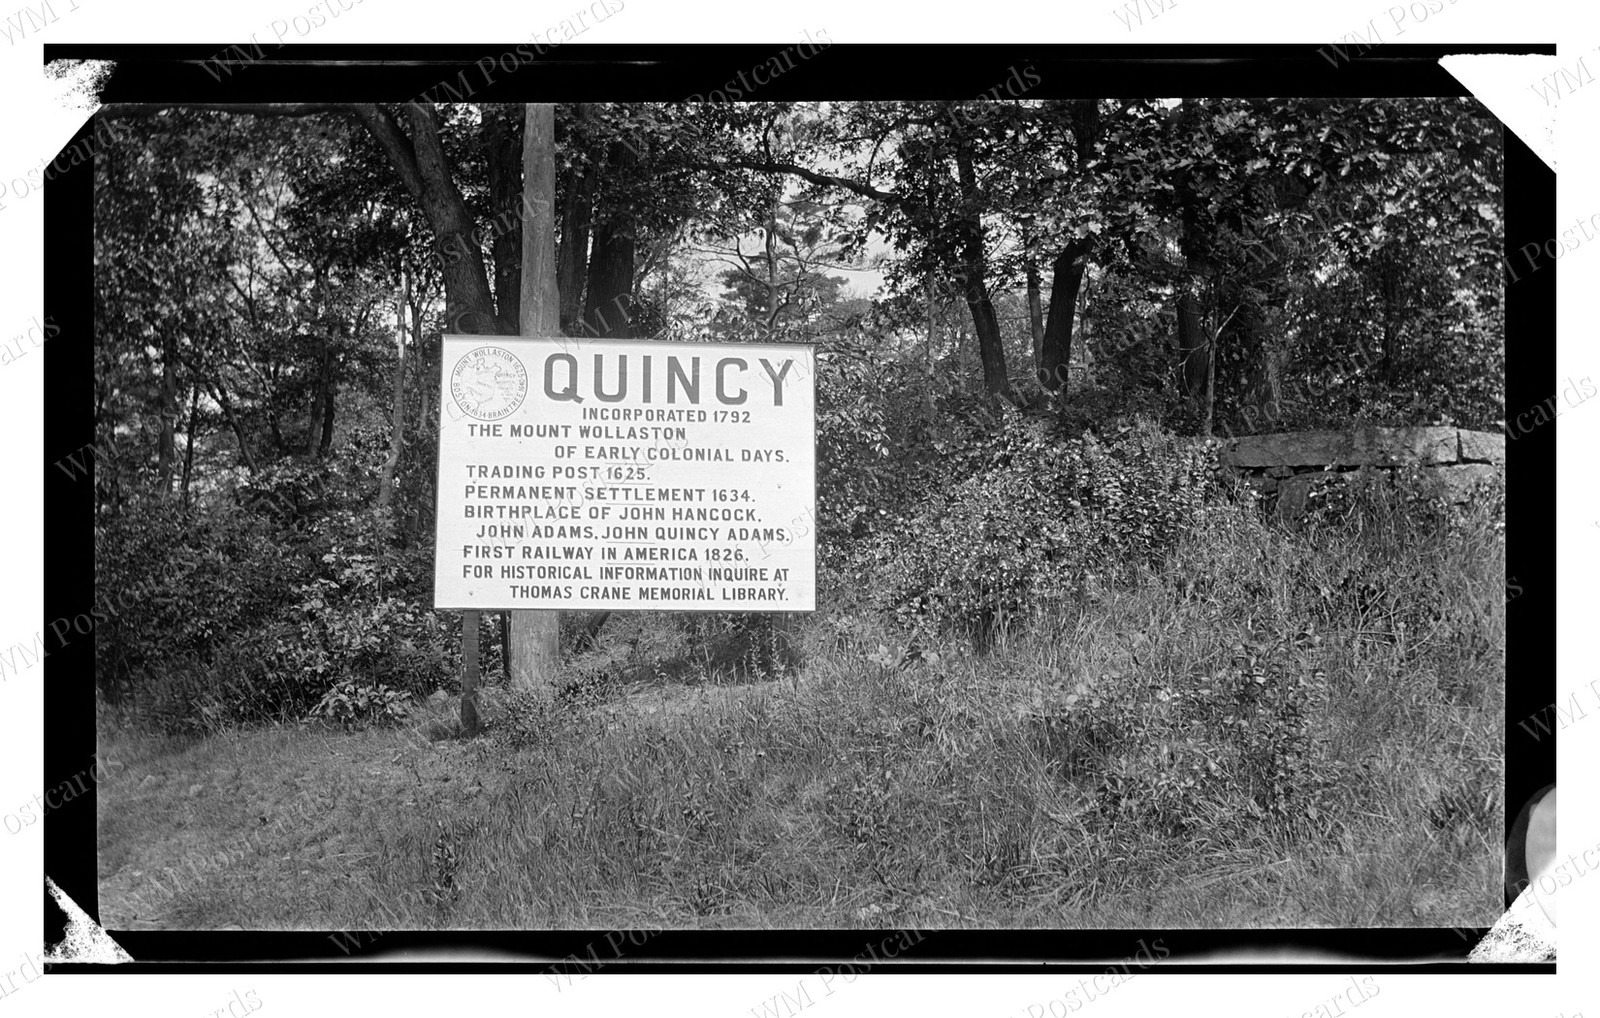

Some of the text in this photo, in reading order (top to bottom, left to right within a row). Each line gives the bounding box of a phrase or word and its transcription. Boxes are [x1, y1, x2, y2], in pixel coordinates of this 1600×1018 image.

[455, 356, 472, 377] MOUNT
[472, 348, 515, 363] WOLLASTON
[543, 353, 794, 407] QUINCY
[488, 392, 524, 419] BRAINTREE
[582, 407, 751, 423] INCORPORATED 1792
[467, 423, 686, 440] THE MOUNT WOLLASTON
[554, 445, 789, 462] OF EARLY COLONIAL DAYS.
[466, 465, 650, 480] TRADING POST 1625.
[465, 485, 755, 502] PERMANENT SETTLEMENT 1634.
[464, 505, 581, 519] BIRTHPLACE
[588, 506, 611, 520] OF
[619, 506, 665, 521] JOHN
[476, 524, 524, 538] JOHN
[602, 526, 648, 540] JOHN
[655, 526, 719, 541] QUINCY
[728, 528, 790, 541] ADAMS.
[463, 545, 749, 561] FIRST RAILWAY IN AMERICA 1826.
[463, 564, 790, 582] FOR HISTORICAL INFORMATION INQUIRE AT
[509, 585, 789, 601] THOMAS CRANE MEMORIAL LIBRARY.
